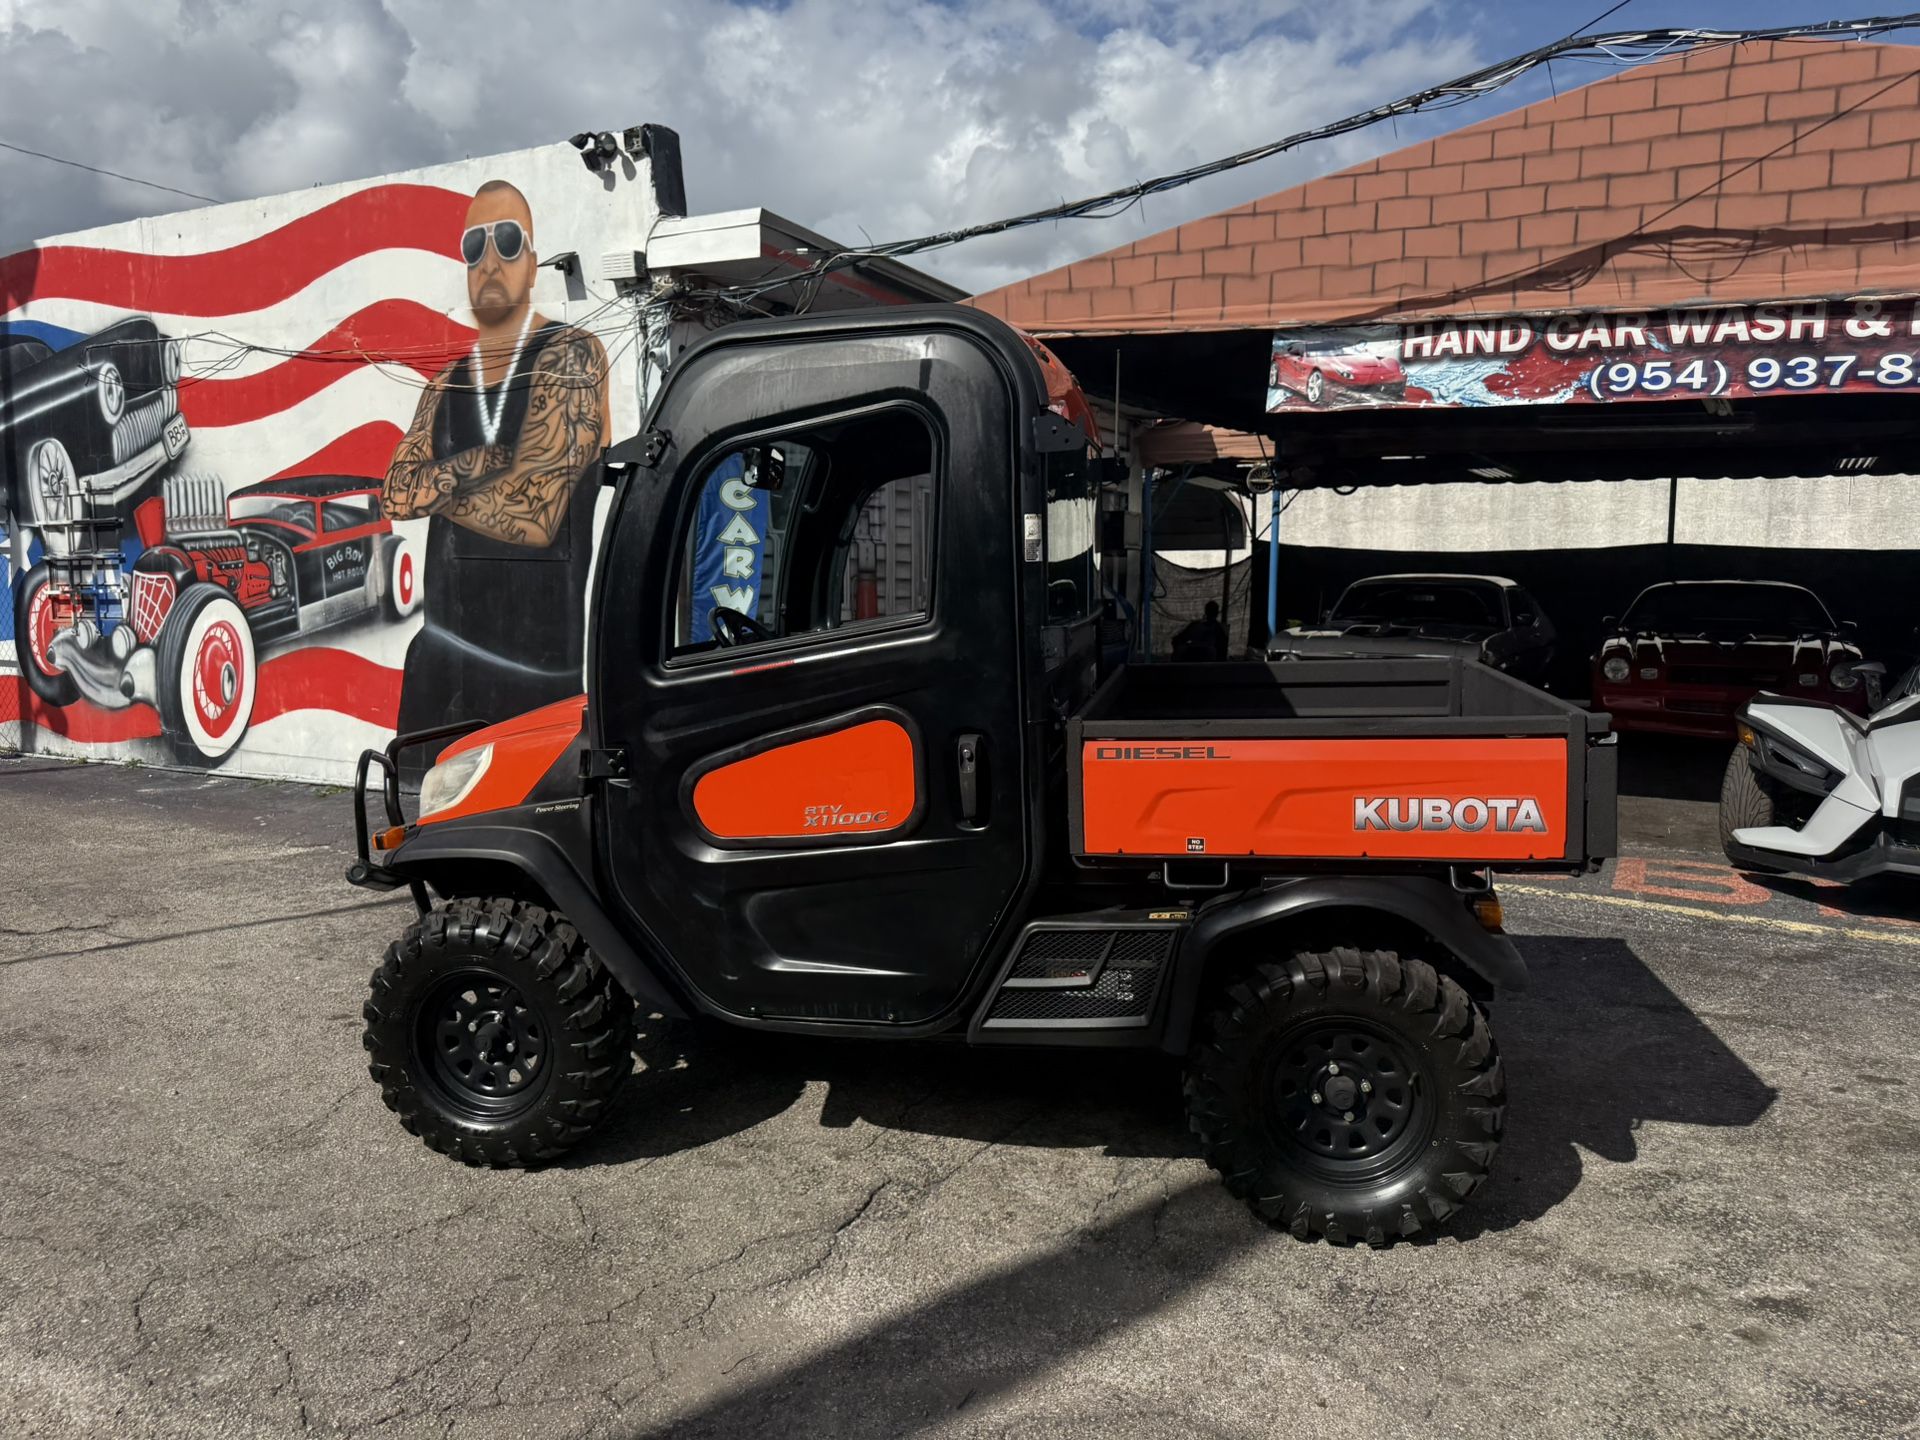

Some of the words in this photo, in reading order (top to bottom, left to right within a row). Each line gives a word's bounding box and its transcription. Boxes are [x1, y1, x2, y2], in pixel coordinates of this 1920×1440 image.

[1403, 320, 1534, 358] HAND
[1546, 313, 1648, 351] CAR
[1668, 303, 1827, 345] WASH
[1846, 299, 1892, 339] &
[1590, 360, 1728, 399] (954)
[1748, 354, 1920, 389] 937-8
[326, 550, 344, 570] BIG
[344, 546, 364, 562] BOY
[1096, 746, 1231, 760] DIESEL
[803, 810, 889, 827] X1100C
[804, 804, 844, 815] RTV
[1353, 797, 1547, 832] KUBOTA
